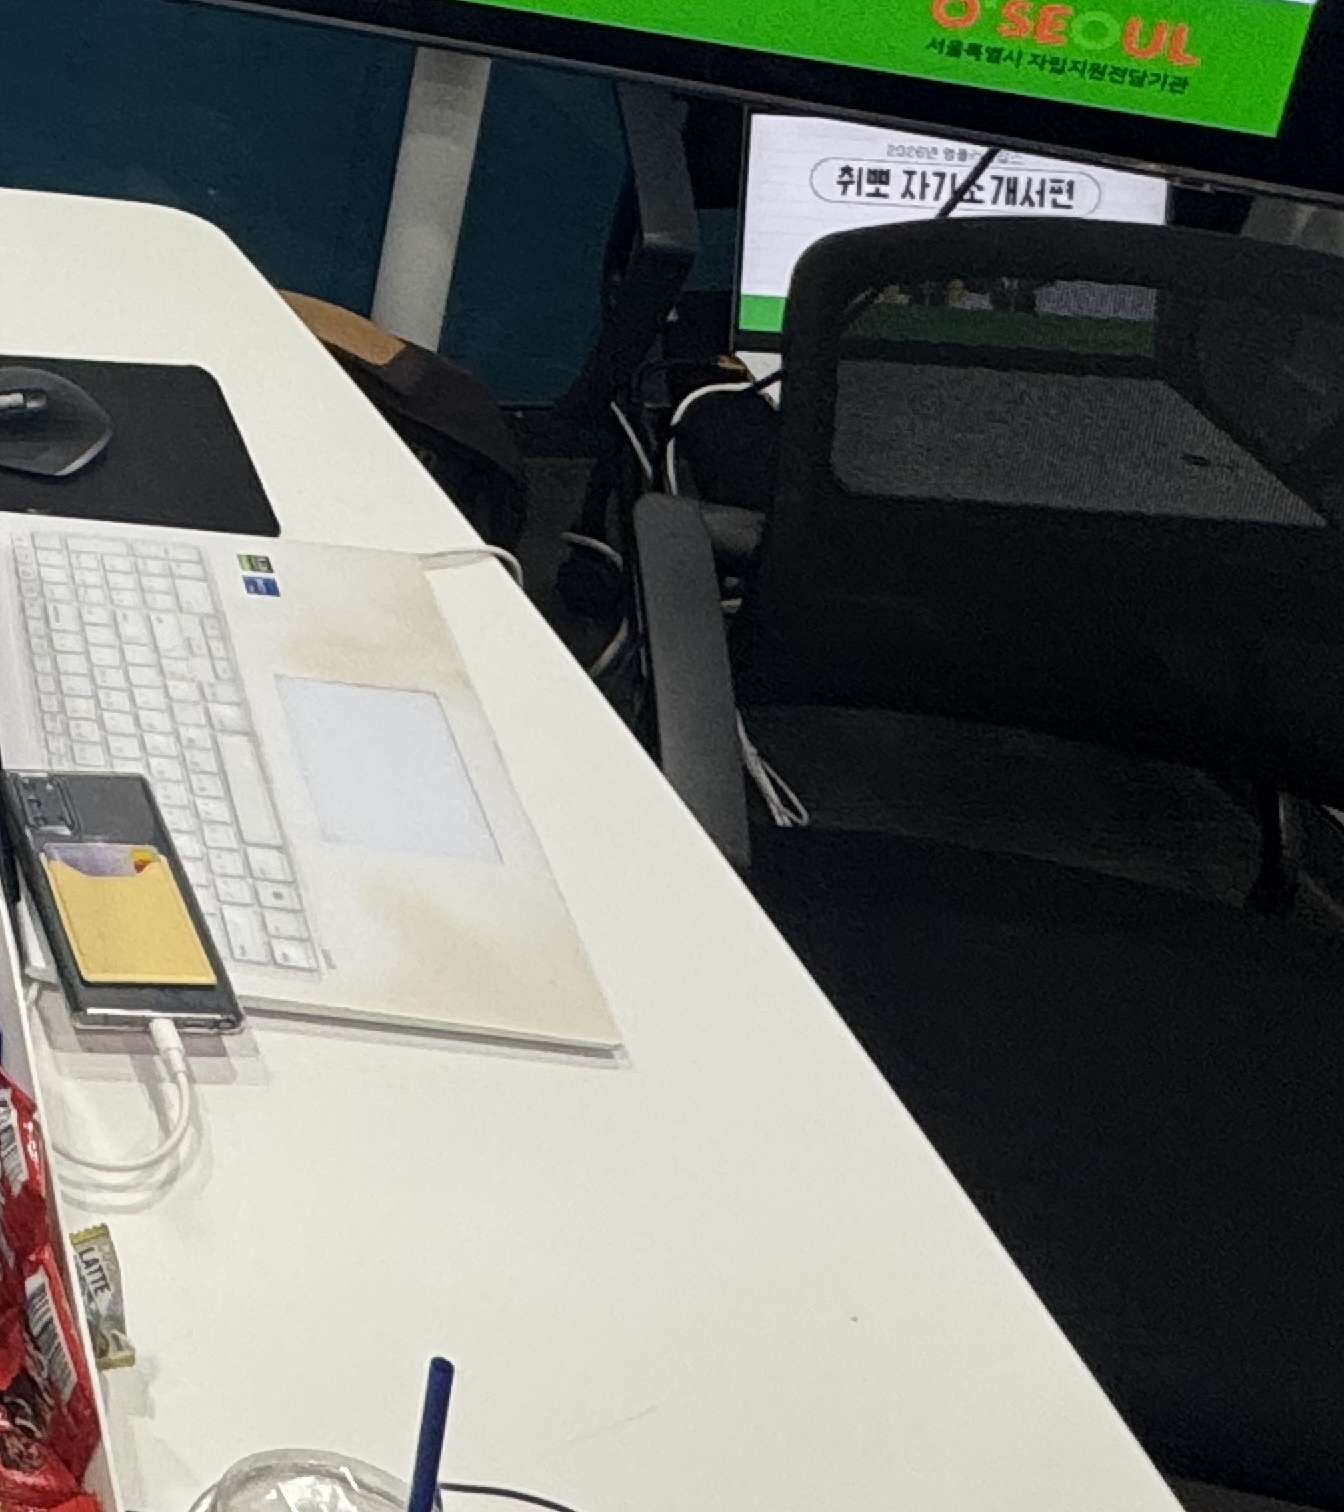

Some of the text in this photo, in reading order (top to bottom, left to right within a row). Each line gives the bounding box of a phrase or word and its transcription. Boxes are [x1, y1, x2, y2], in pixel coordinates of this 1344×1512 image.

[924, 37, 1190, 95] 서울특별시 자립지원전담기관
[836, 165, 891, 199] 취뽀
[78, 1246, 112, 1297] LATTE
